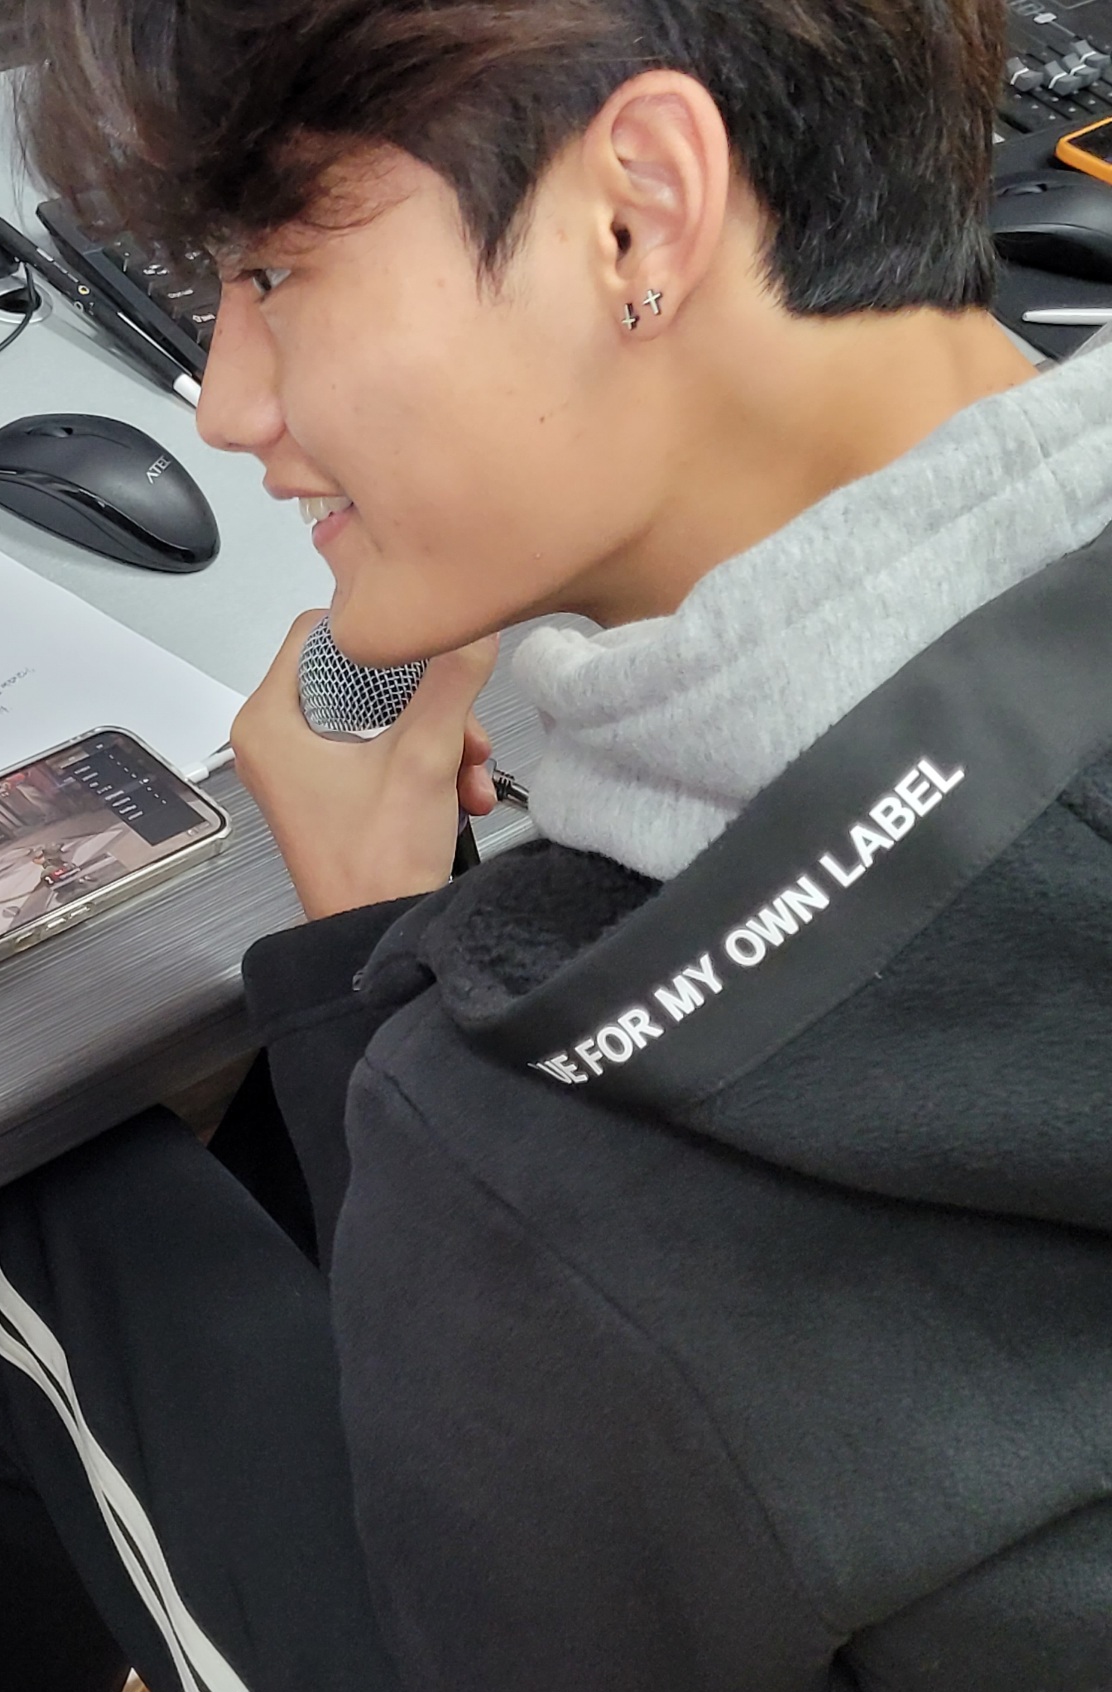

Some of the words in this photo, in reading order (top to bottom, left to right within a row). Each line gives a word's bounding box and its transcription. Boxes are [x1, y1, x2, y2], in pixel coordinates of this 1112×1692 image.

[575, 1008, 664, 1076] FOR
[654, 953, 723, 1022] MY
[725, 875, 829, 967] OWN
[820, 757, 965, 888] LABEL
